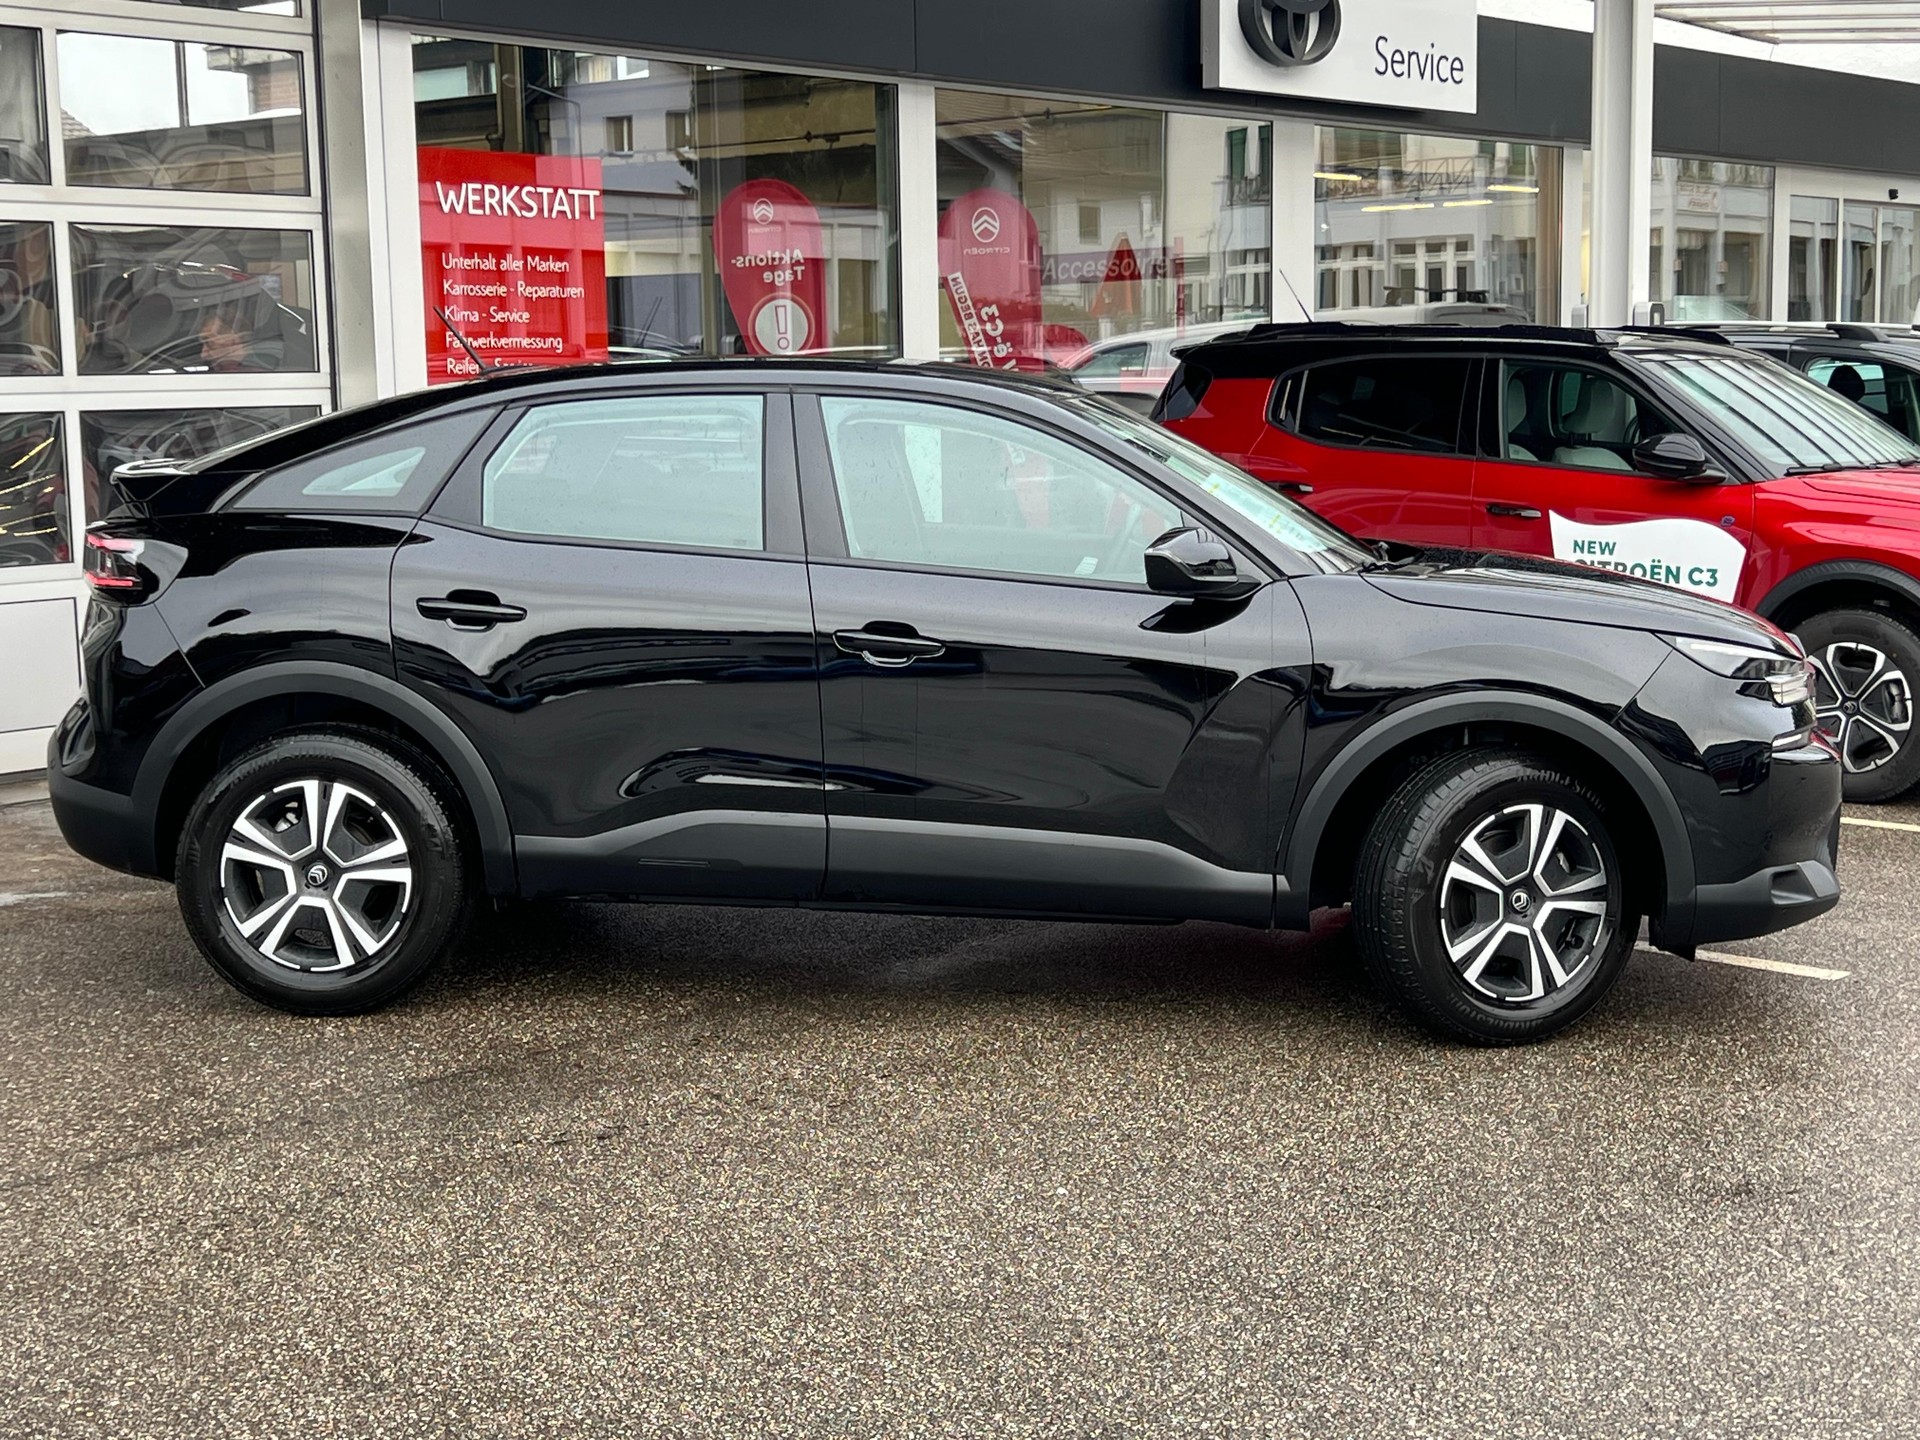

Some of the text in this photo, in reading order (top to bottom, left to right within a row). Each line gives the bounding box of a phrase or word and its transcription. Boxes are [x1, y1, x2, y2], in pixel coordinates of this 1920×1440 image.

[1375, 36, 1464, 84] Service
[435, 181, 600, 220] WERKSTATT
[442, 252, 569, 273] Unterhalt aller Marken
[443, 280, 507, 298] Karrosserie
[517, 283, 585, 301] Reparaturen
[445, 306, 479, 323] Klima
[489, 307, 530, 324] Service
[1572, 539, 1617, 556] NEW
[1687, 567, 1718, 587] C3
